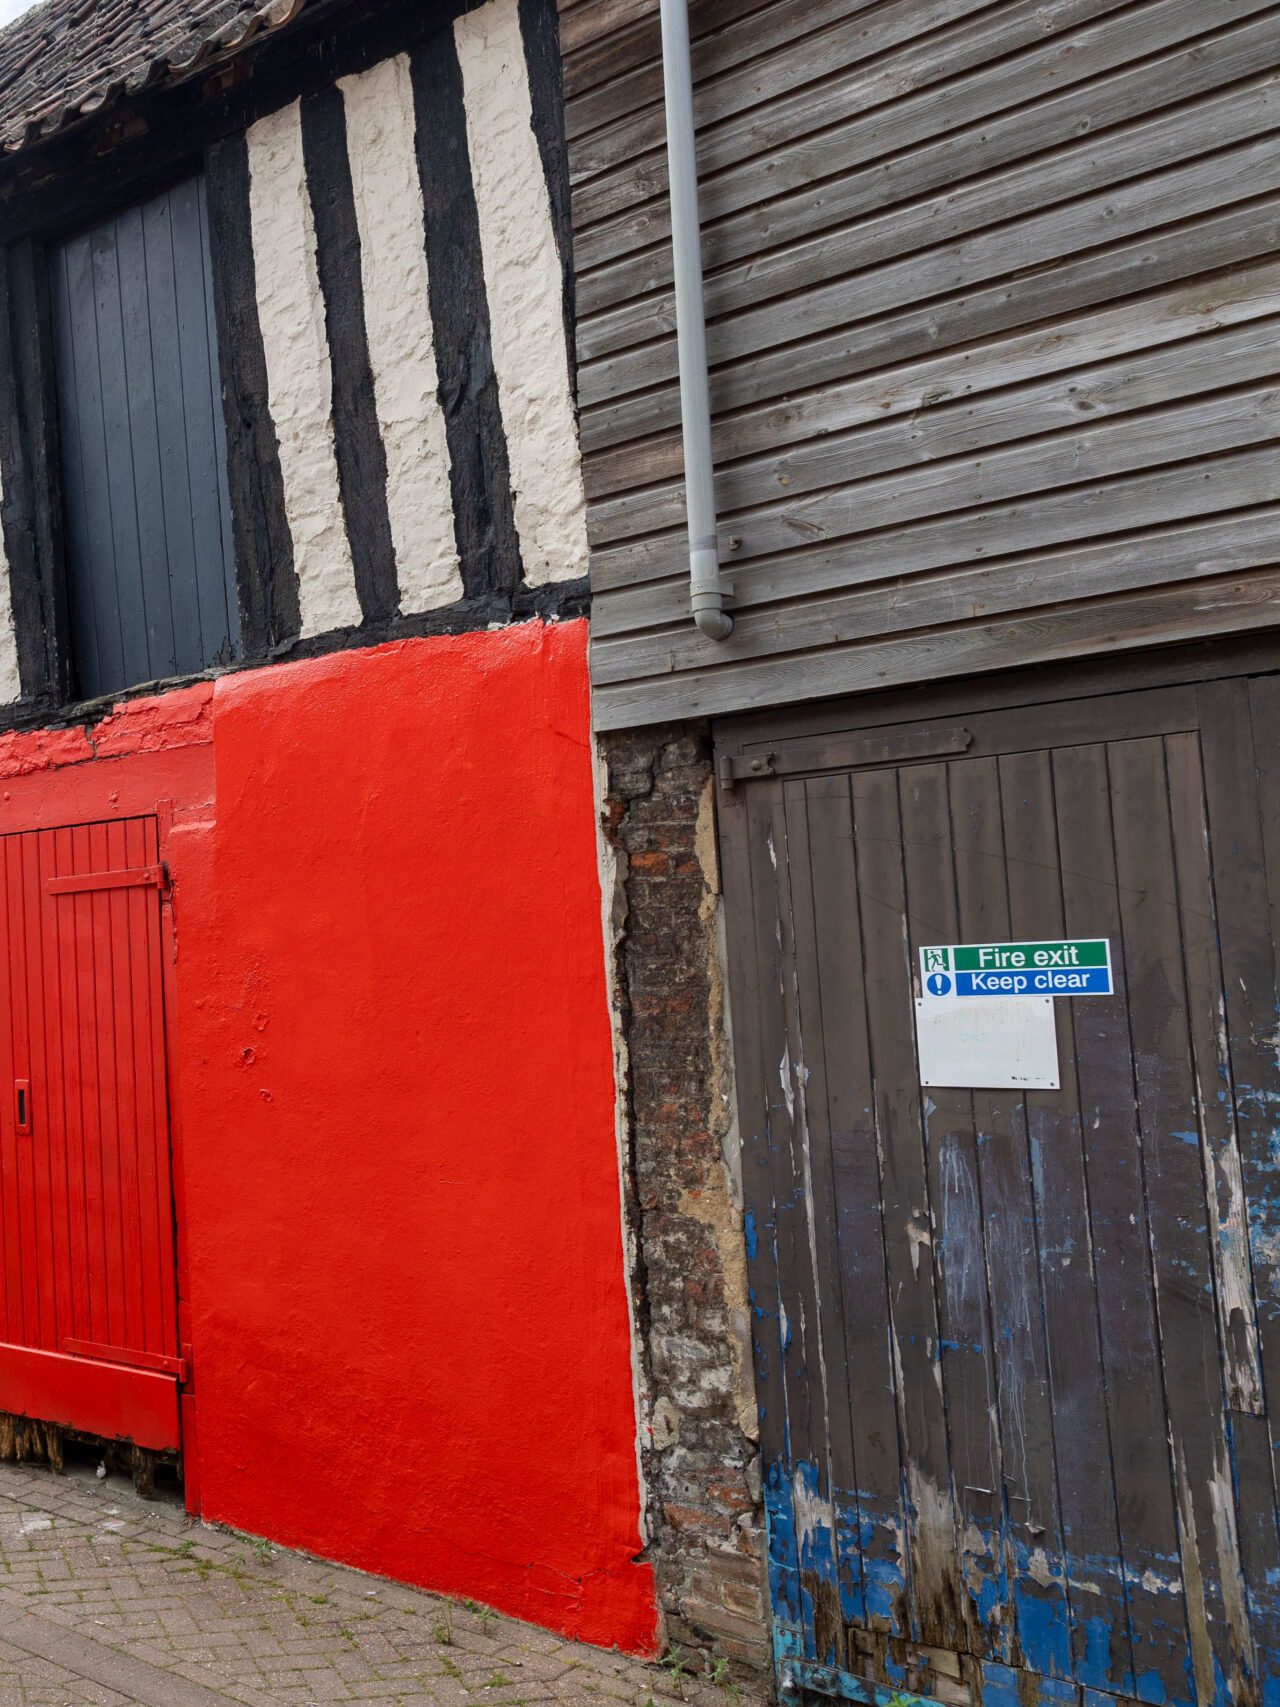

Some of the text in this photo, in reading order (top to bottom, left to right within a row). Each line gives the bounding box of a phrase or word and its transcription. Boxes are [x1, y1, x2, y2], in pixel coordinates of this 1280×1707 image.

[978, 945, 1080, 967] Fire exit
[971, 971, 1090, 993] Keep clear
